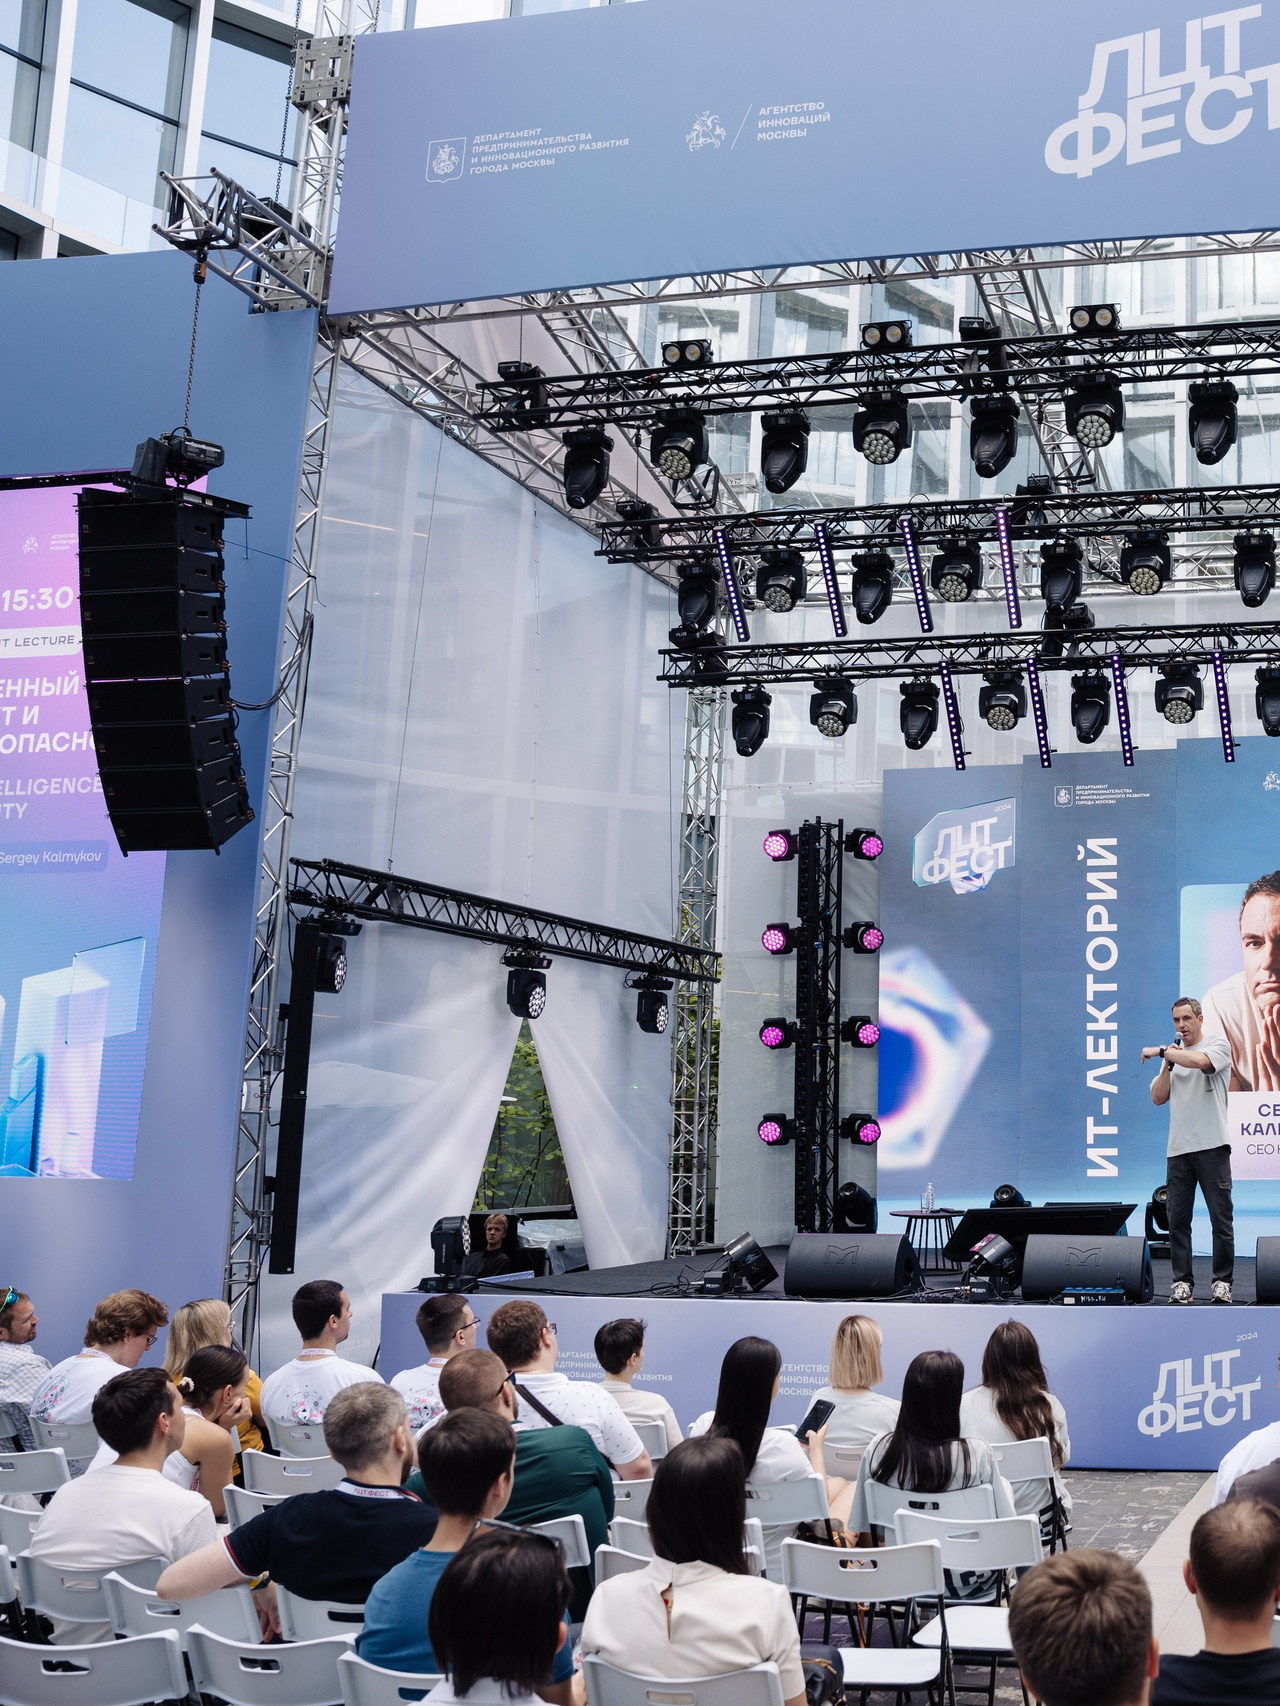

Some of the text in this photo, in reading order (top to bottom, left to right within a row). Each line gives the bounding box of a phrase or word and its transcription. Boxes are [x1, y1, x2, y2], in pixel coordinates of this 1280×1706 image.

[759, 102, 825, 116] АГЕНТСТВО
[758, 112, 831, 128] ИННОВАЦИЙ
[472, 132, 592, 153] ПРЕДПРИНИМАТЕЛЬСТВА
[473, 128, 542, 144] ДЕПАРТАМЕНТ
[757, 128, 807, 141] МОСКВЫ
[471, 138, 629, 164] И ИННОВАЦИОННОГО РАЗВИТИЯ
[470, 158, 555, 175] ГОРОДА МОСКВЫ
[2, 586, 74, 611] 15:30
[15, 635, 75, 647] LECTURE
[994, 803, 1012, 812] 2024
[0, 851, 102, 866] Sergey Kalmykov
[922, 835, 1012, 884] ФЕСТ
[1077, 838, 1119, 1177] ИТ-ЛЕКТОРИЙ
[1236, 1332, 1258, 1342] 2024
[632, 1373, 673, 1381] РАЗВИТИЯ
[1137, 1375, 1261, 1438] ФЕСТ
